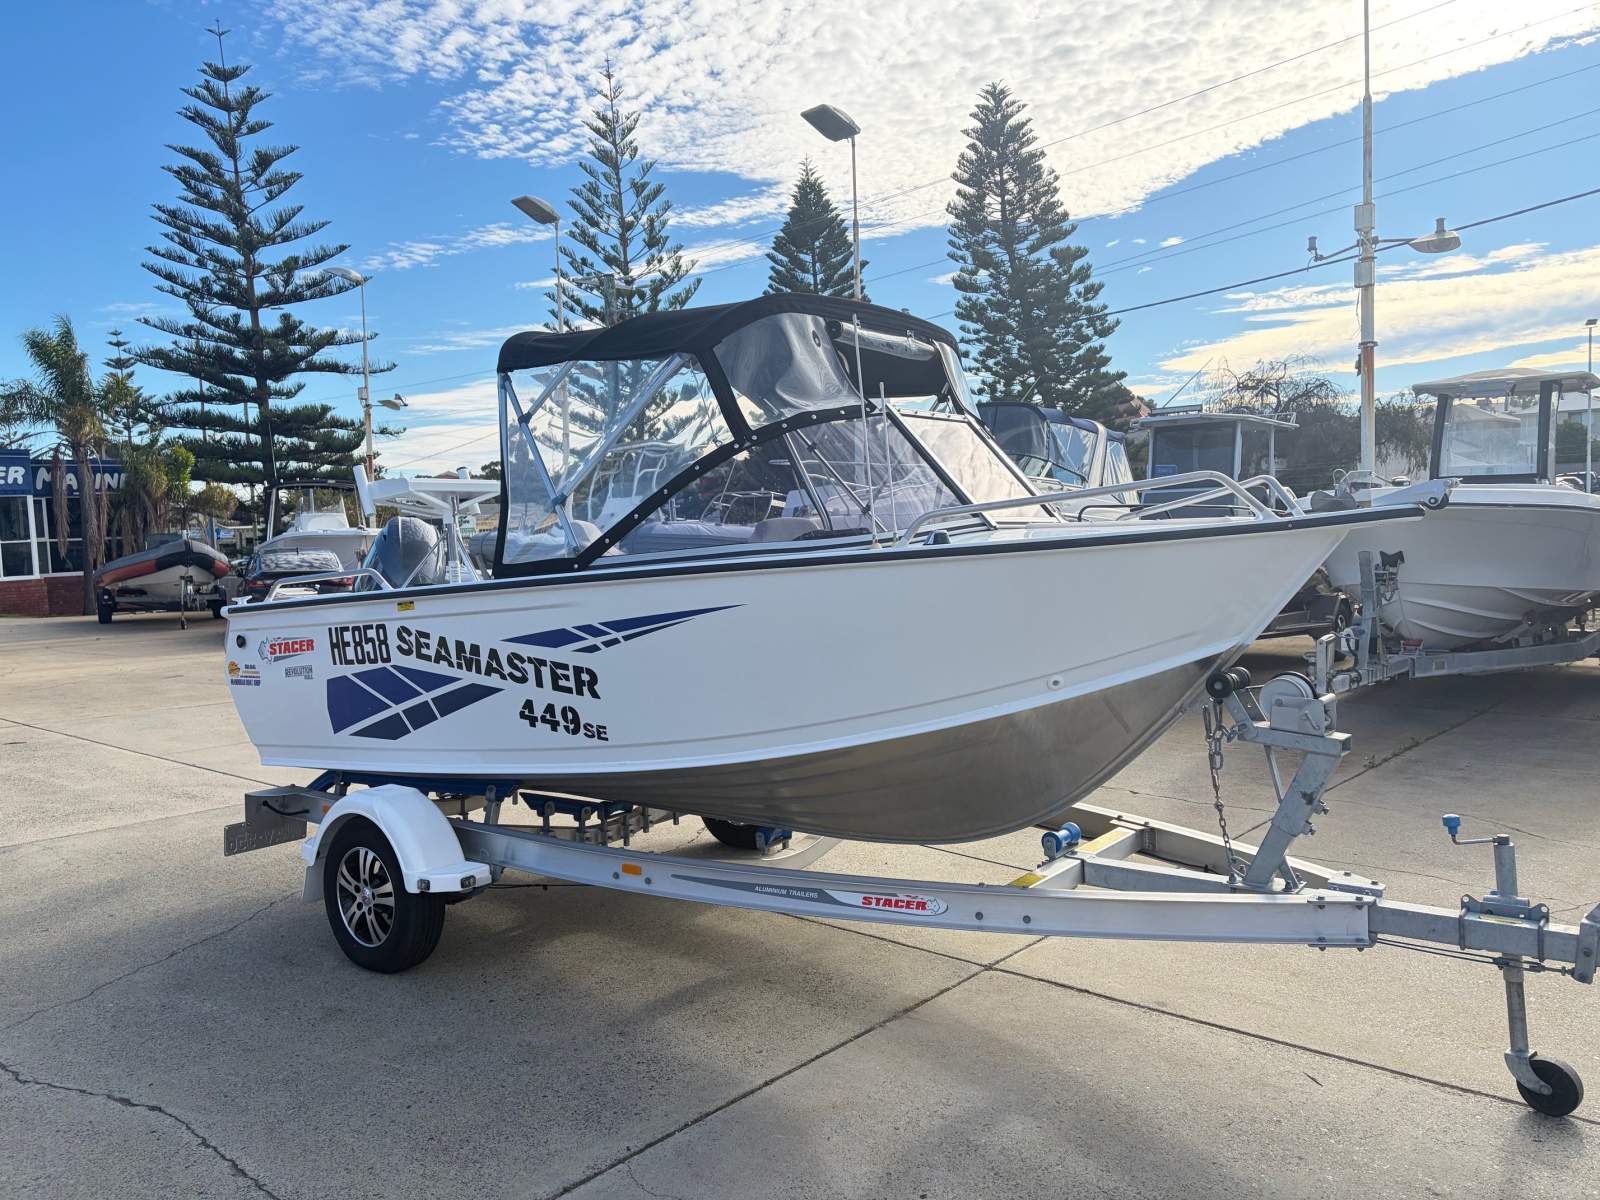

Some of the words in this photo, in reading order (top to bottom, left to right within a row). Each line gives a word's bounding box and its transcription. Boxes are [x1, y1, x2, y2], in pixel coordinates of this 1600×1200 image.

[269, 639, 315, 656] STACER
[328, 623, 391, 665] HE858
[396, 625, 601, 699] SEAMASTER
[789, 889, 819, 899] TRAILERS
[862, 896, 927, 911] STACER
